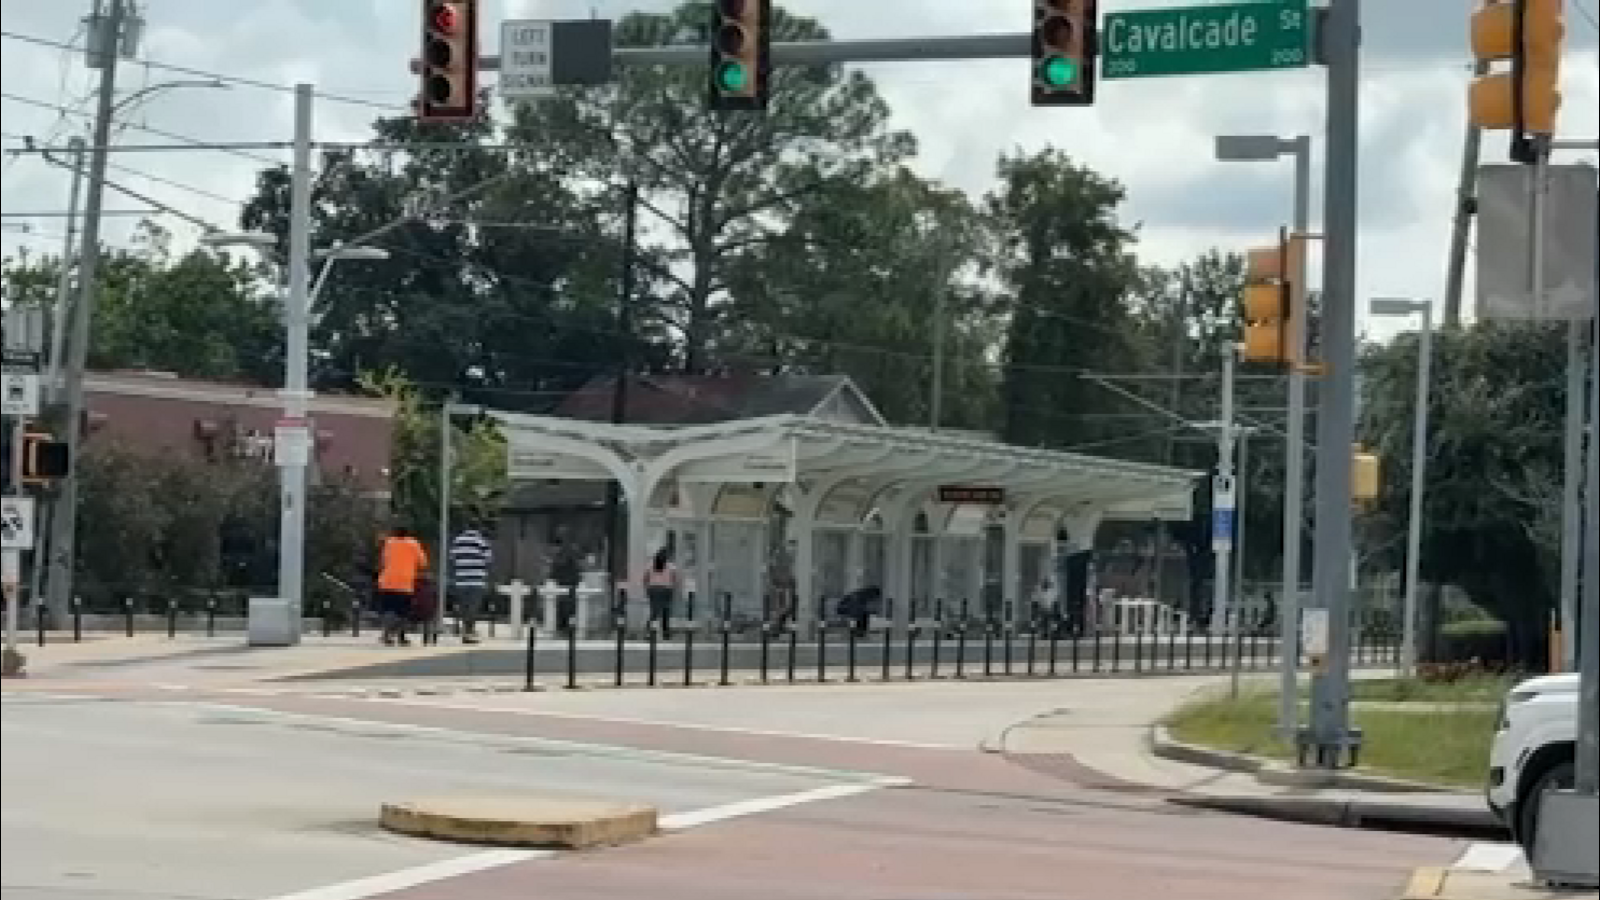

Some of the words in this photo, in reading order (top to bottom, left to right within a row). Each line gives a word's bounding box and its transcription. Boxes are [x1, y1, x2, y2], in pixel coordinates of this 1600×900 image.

[513, 28, 547, 46] LEFT
[1108, 11, 1258, 53] Cavalcade
[1280, 9, 1301, 30] St
